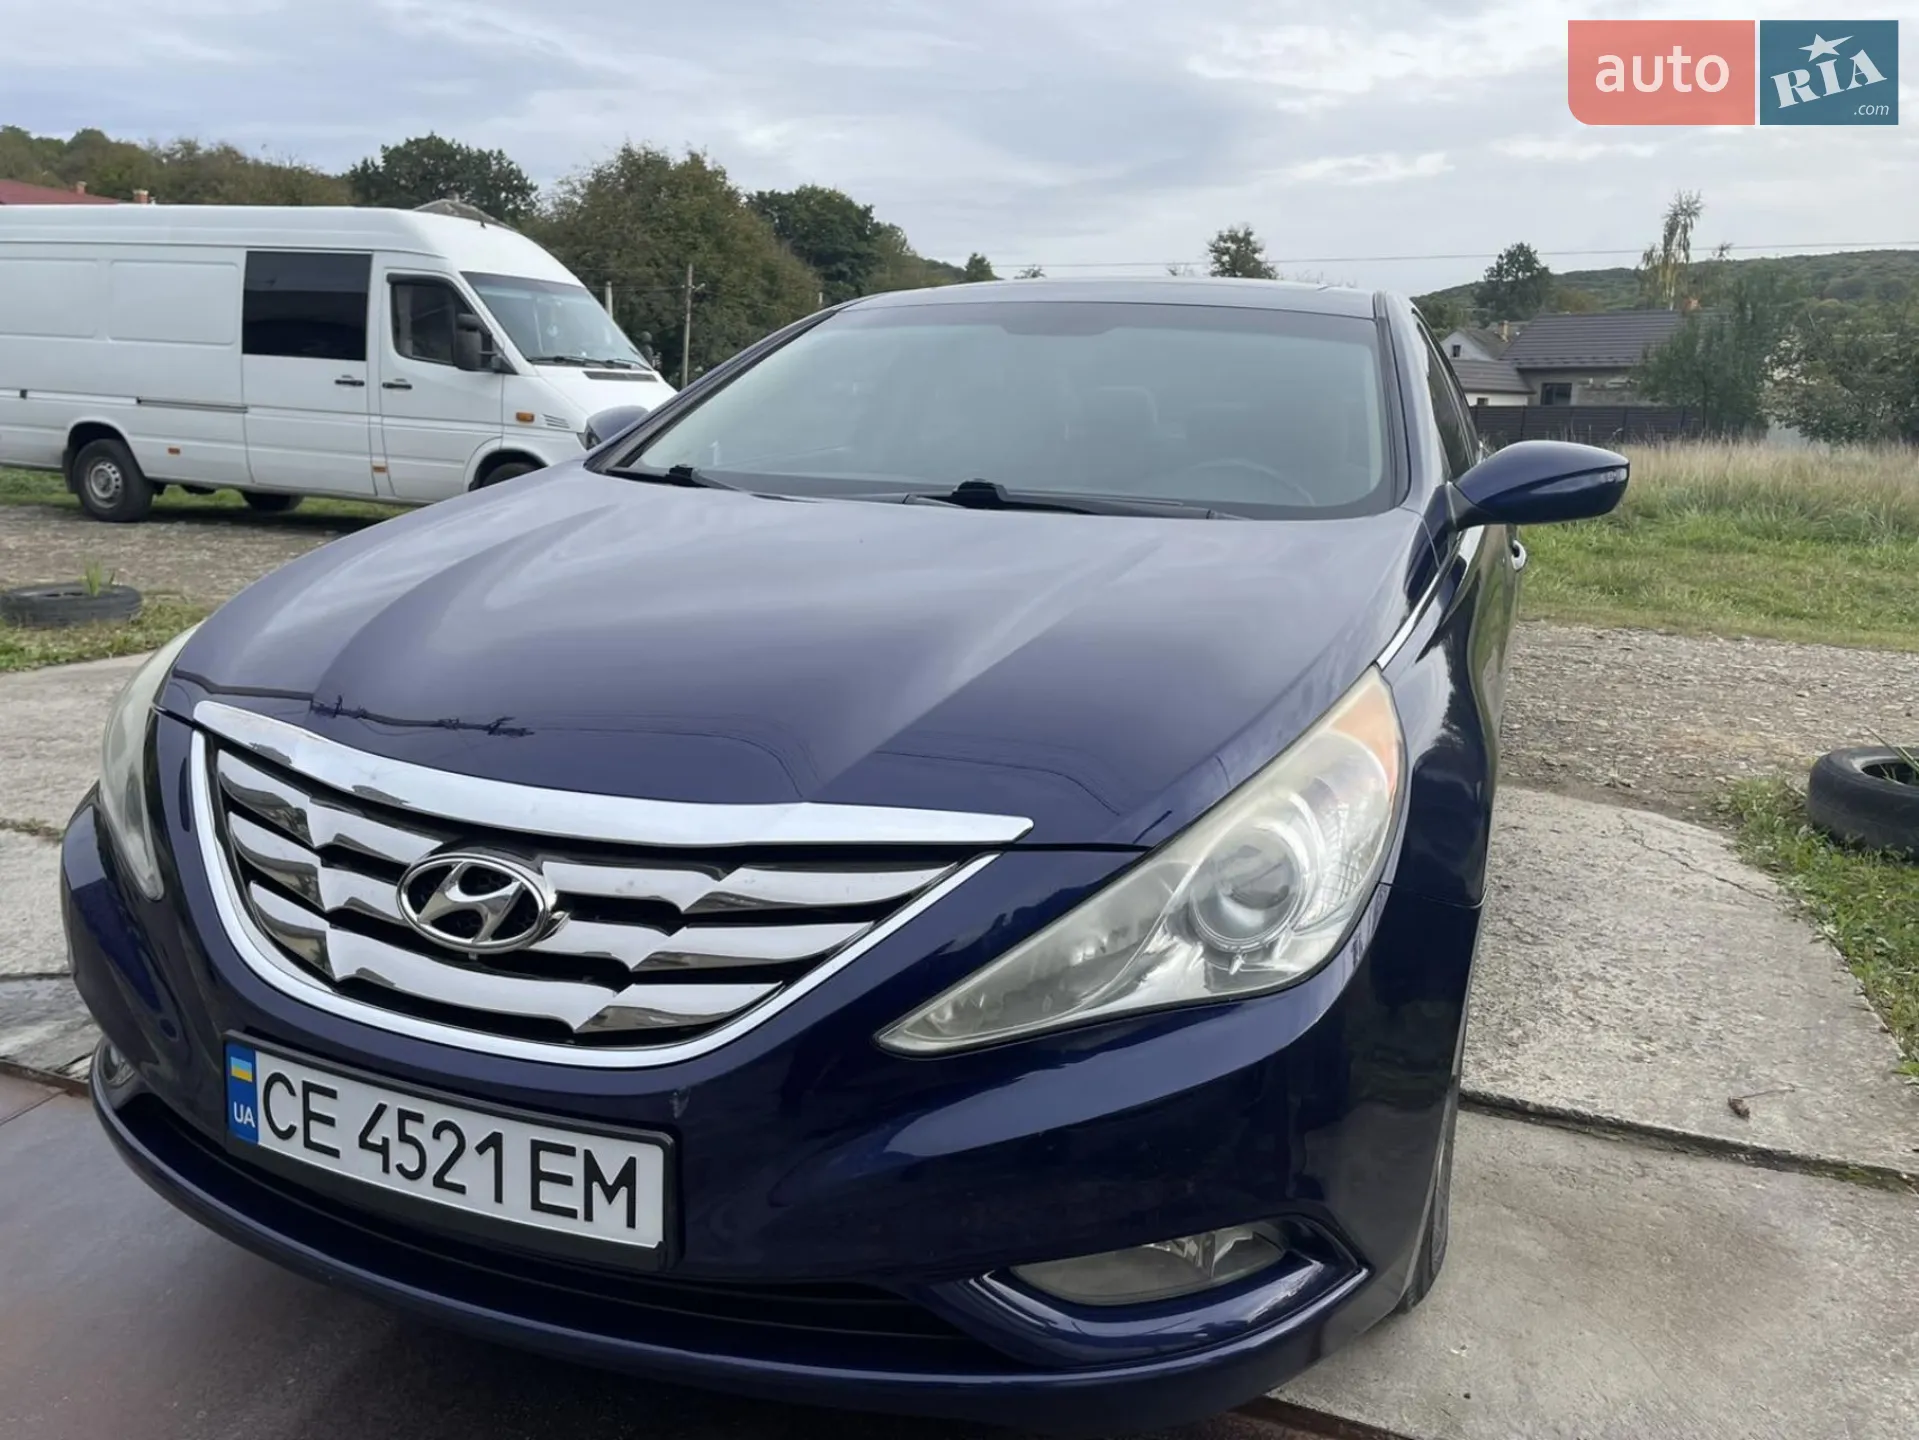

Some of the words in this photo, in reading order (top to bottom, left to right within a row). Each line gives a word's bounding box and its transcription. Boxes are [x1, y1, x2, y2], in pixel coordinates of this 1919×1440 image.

[234, 1103, 256, 1129] UA
[262, 1071, 340, 1159] CE
[358, 1102, 503, 1205] 4521
[530, 1138, 637, 1230] EM
